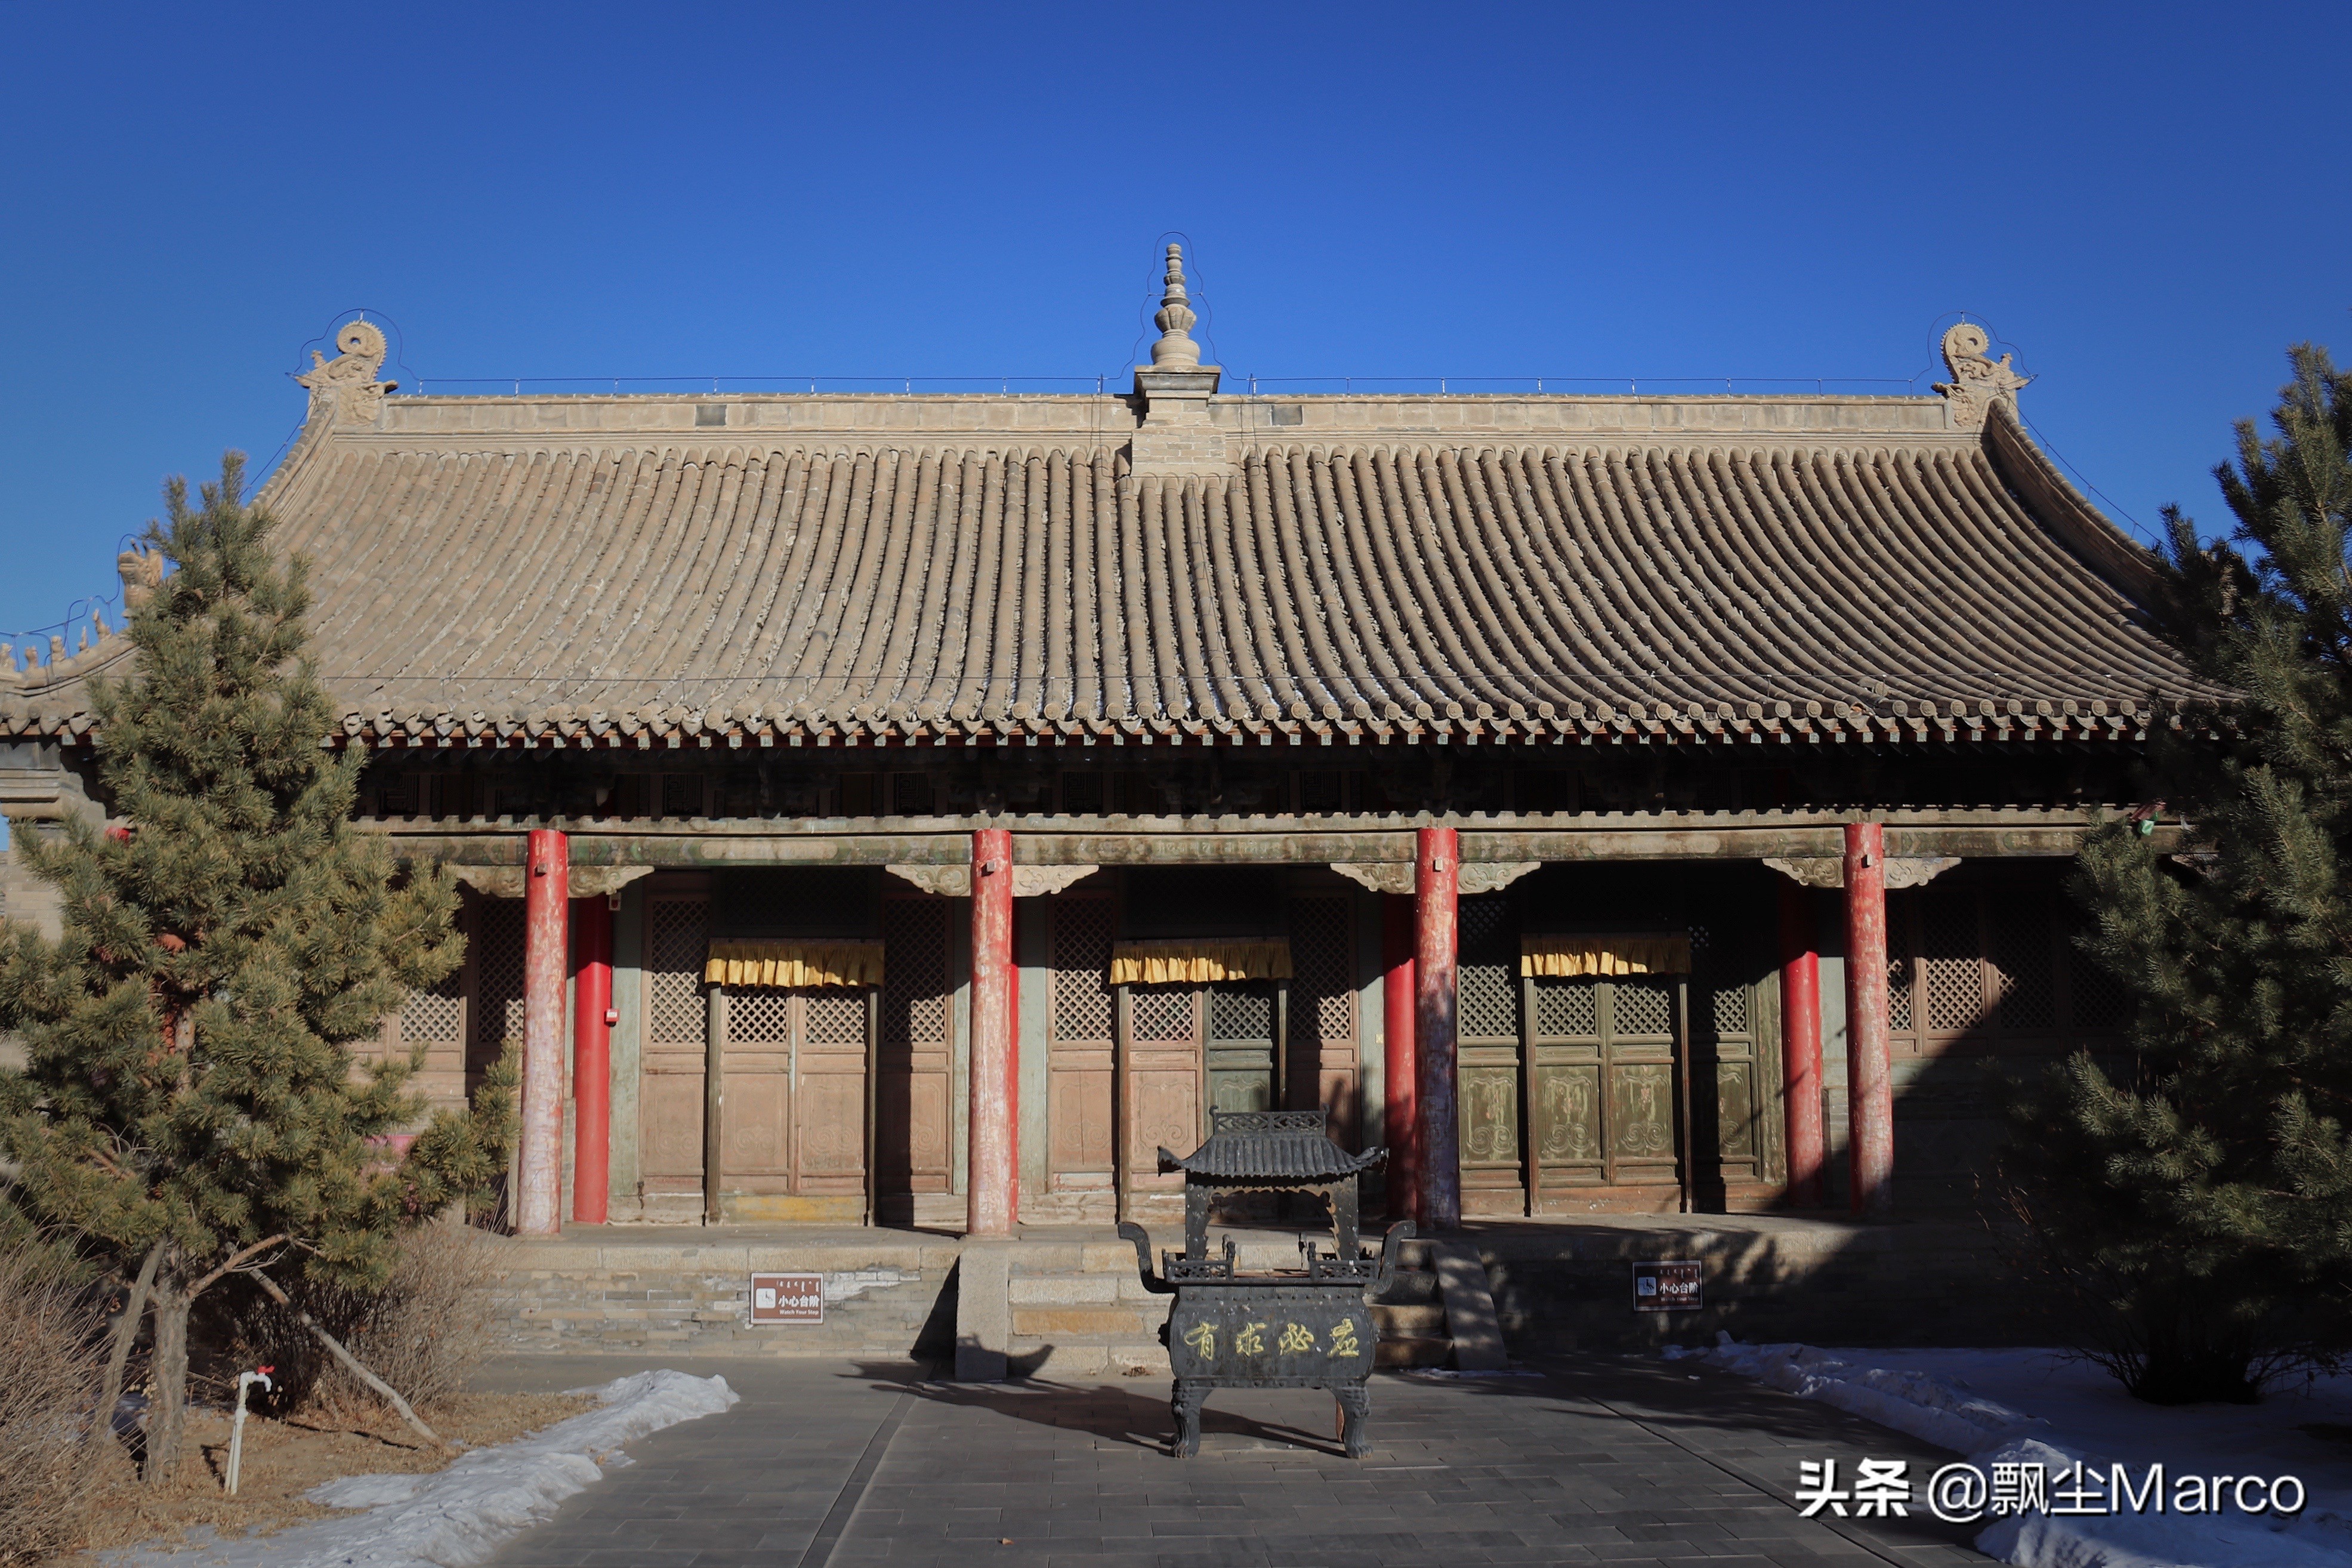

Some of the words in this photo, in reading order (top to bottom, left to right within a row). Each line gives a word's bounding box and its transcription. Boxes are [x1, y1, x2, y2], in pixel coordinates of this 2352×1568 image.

[1659, 1282, 1699, 1294] 小心台阶
[778, 1294, 820, 1307] 小心台阶
[1183, 1317, 1360, 1362] 有求必应
